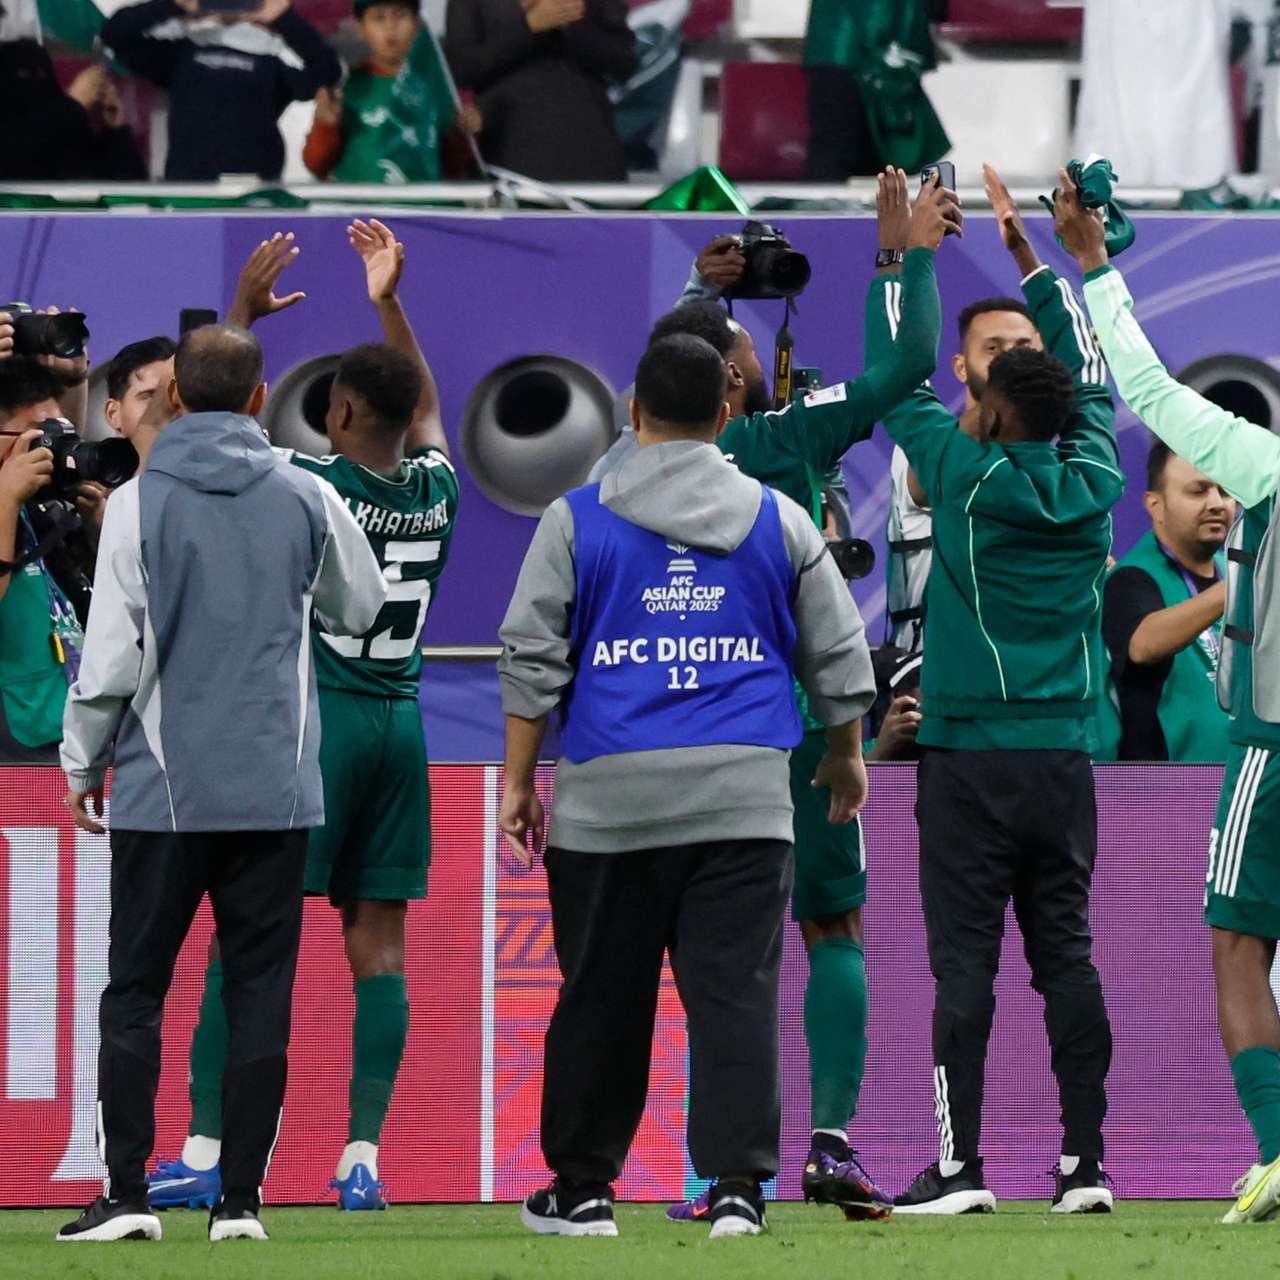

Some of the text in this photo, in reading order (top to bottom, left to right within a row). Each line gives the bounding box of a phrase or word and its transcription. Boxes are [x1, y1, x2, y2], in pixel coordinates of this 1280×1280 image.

[670, 576, 693, 587] AFC
[319, 540, 442, 660] 5
[641, 587, 726, 601] ASIAN CUP
[645, 601, 719, 615] QATAR 2023
[592, 637, 764, 665] AFC DIGITAL
[667, 666, 700, 690] 12
